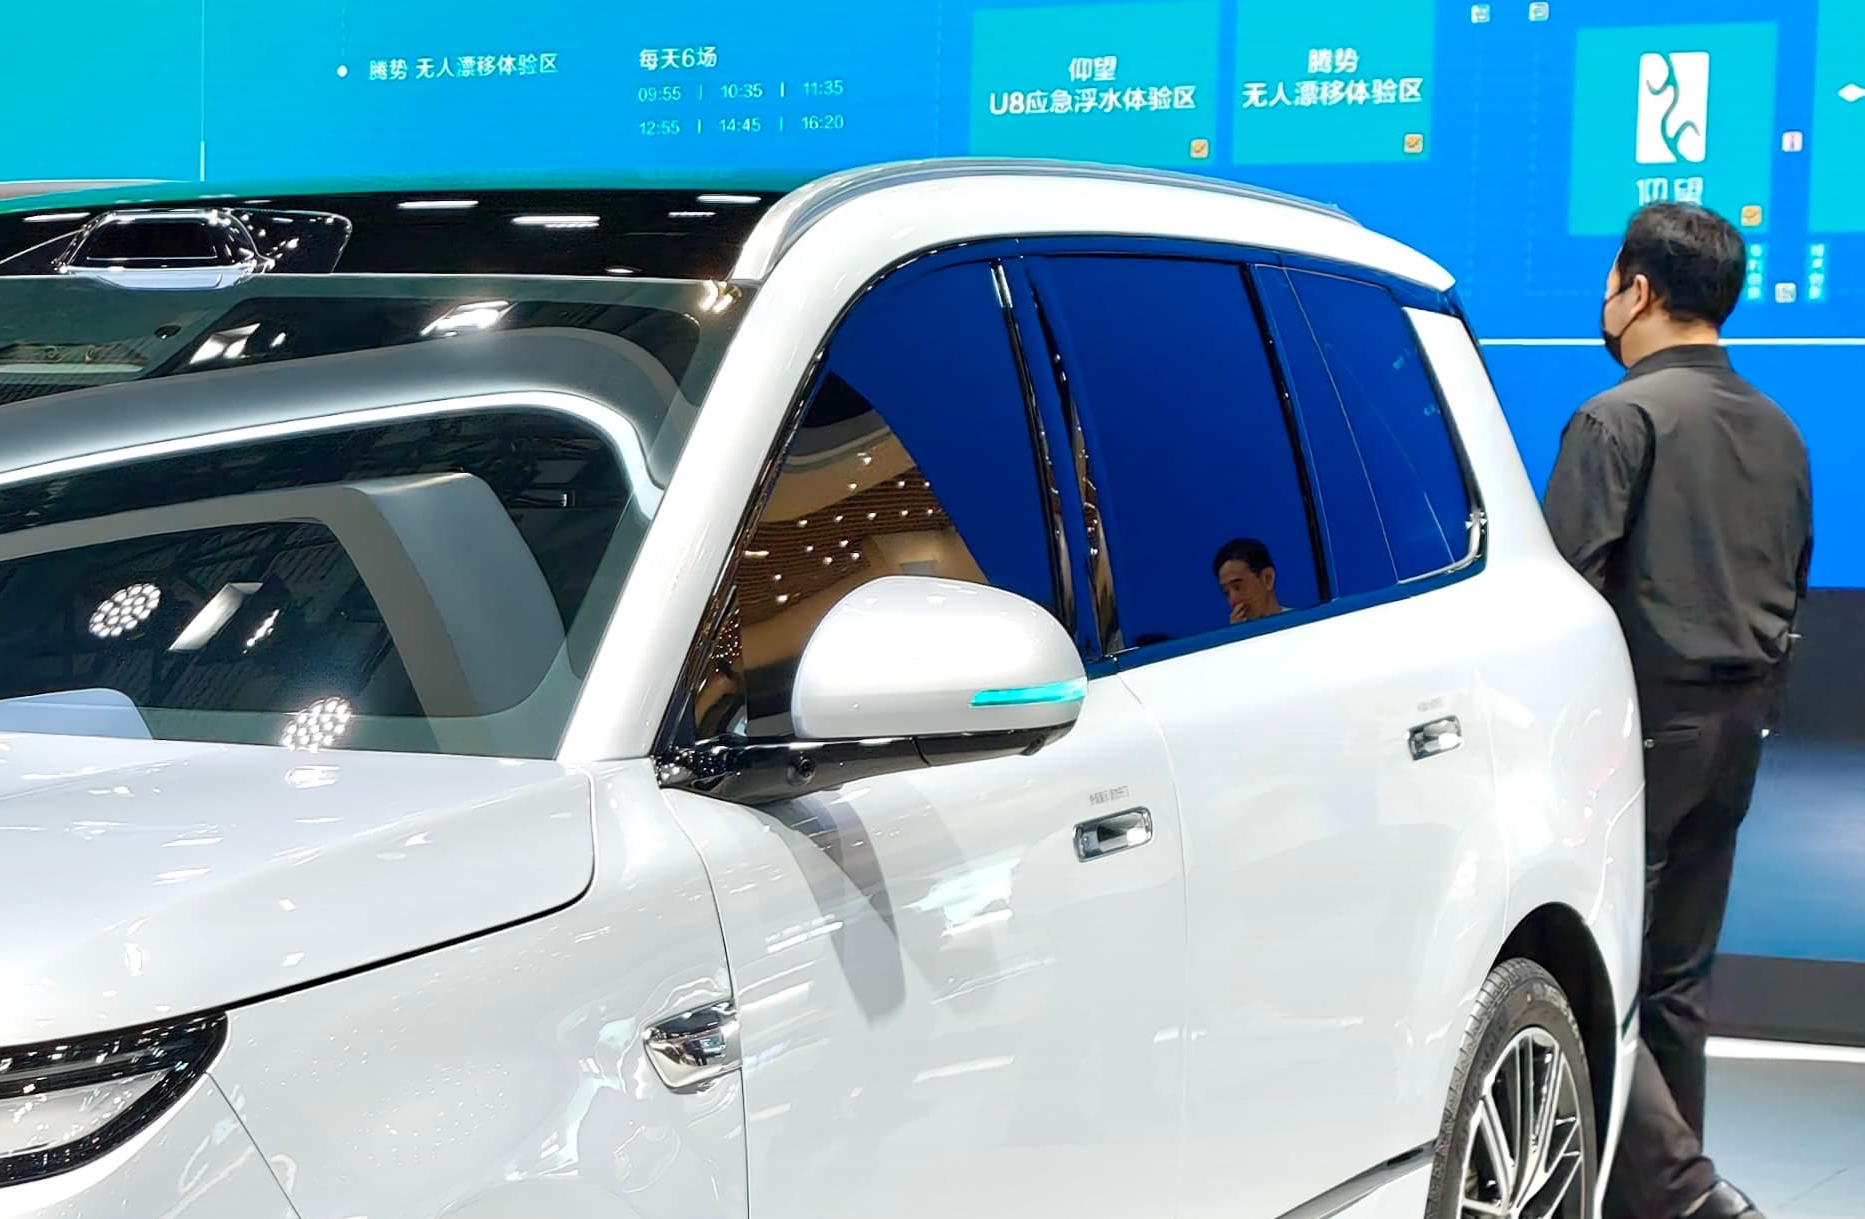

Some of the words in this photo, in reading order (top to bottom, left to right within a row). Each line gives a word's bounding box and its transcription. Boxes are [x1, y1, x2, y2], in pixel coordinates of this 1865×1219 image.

[415, 52, 558, 79] 无人漂移体验区
[639, 46, 717, 71] 每天6场
[1068, 56, 1117, 82] 仰望
[1307, 47, 1359, 73] 腾势
[638, 86, 681, 102] 09:55
[721, 83, 763, 99] 10:35
[803, 79, 843, 96] 11:35
[990, 85, 1196, 115] U8应急浮水体验区
[1242, 77, 1424, 108] 无人漂移体验区
[639, 120, 680, 136] 12:55
[720, 117, 761, 133] 14:45
[802, 114, 844, 130] 16:20
